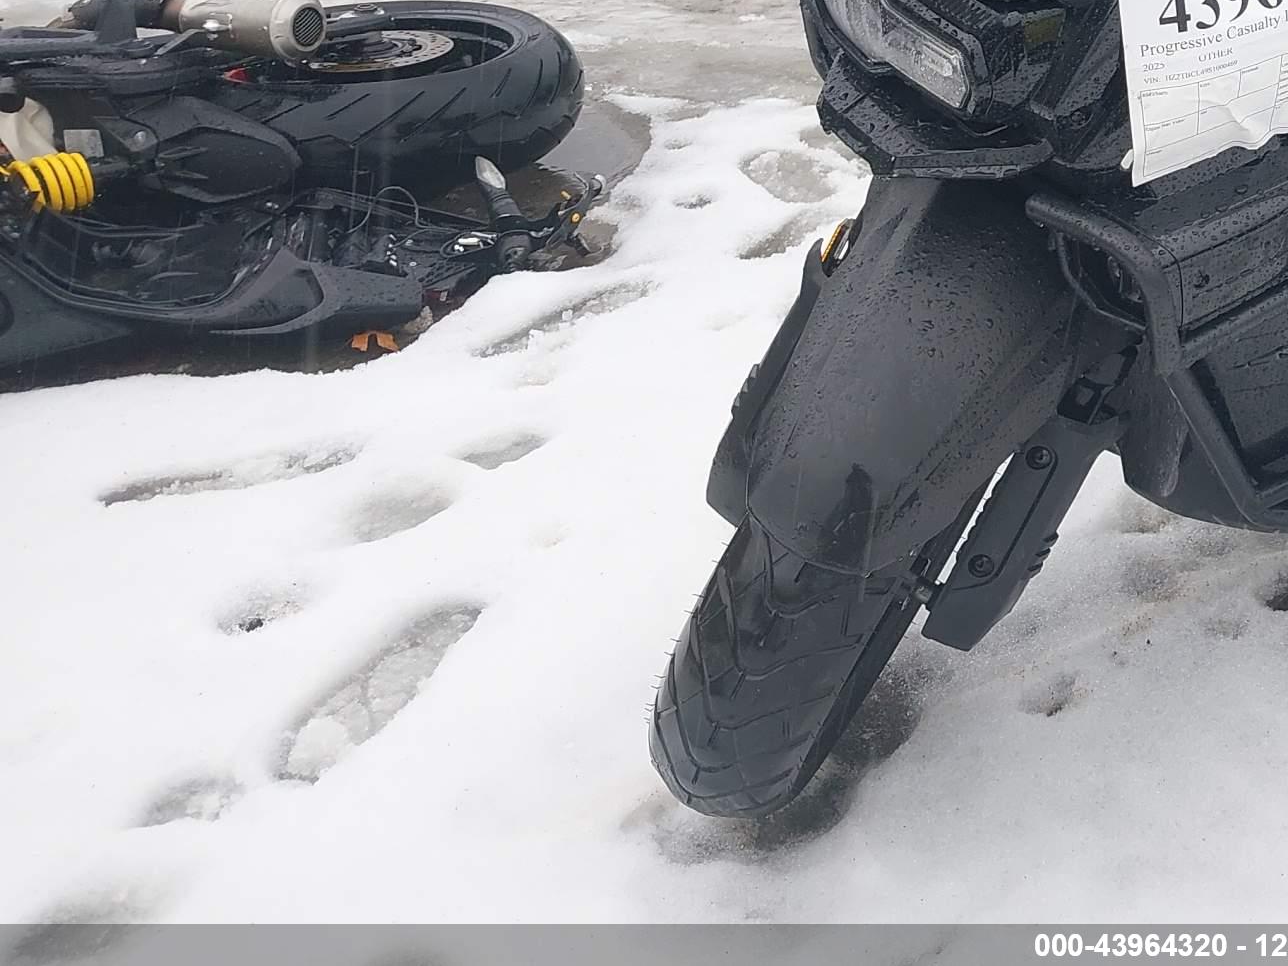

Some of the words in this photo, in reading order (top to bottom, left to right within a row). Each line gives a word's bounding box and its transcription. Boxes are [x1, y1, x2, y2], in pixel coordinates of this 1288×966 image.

[1140, 33, 1223, 58] Progressive
[1227, 11, 1281, 41] Casualty
[1143, 62, 1165, 72] 2025
[1198, 47, 1234, 63] OTHER
[1143, 76, 1161, 84] VIN:
